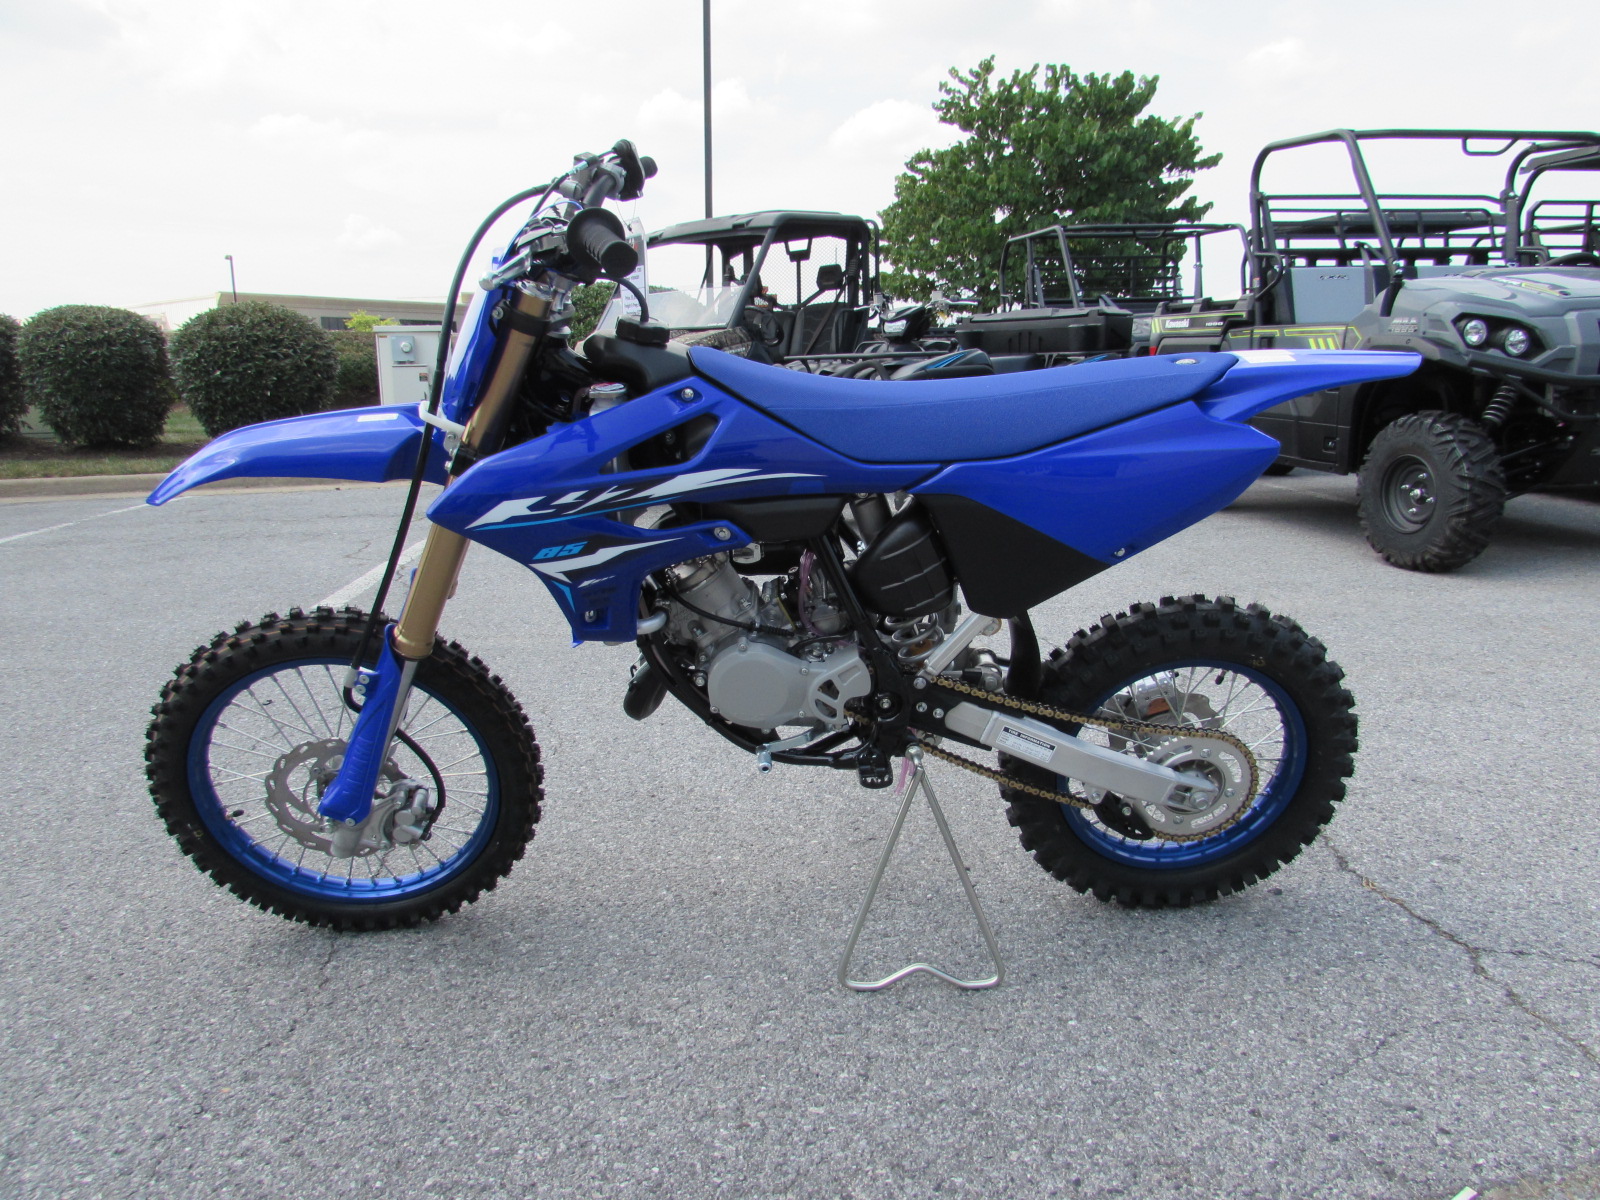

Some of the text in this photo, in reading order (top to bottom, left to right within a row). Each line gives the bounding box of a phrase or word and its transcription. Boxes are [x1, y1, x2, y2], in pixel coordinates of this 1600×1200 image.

[1165, 318, 1190, 328] Kawasaki
[532, 541, 589, 560] 85
[1020, 733, 1051, 749] INFORMATION
